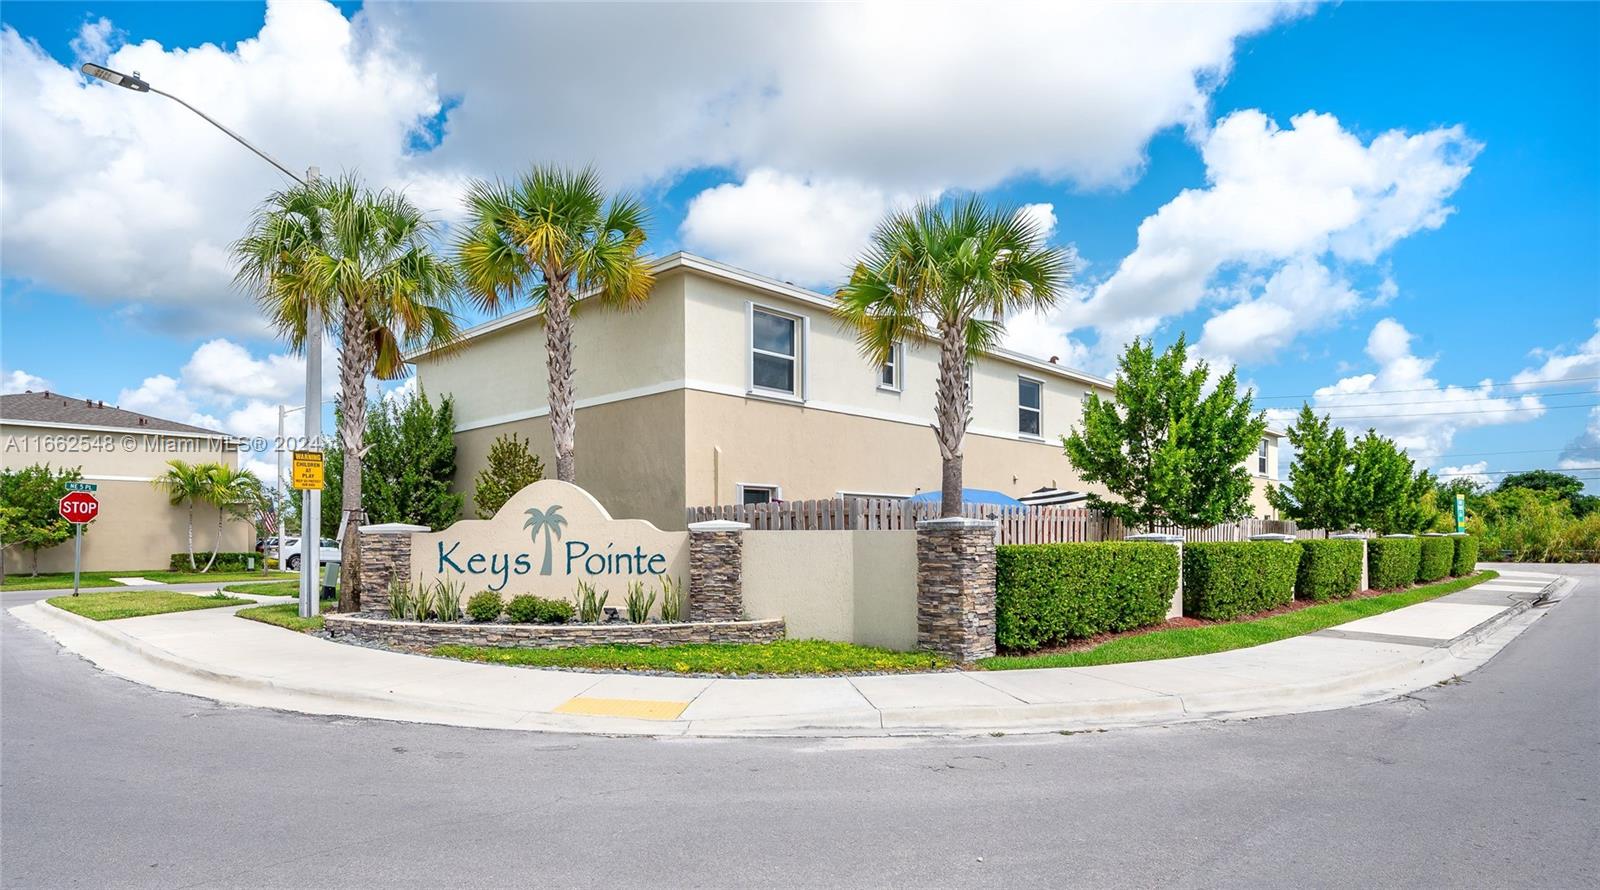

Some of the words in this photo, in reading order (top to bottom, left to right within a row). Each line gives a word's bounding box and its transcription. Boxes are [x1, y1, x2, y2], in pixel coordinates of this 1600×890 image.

[62, 501, 97, 514] STOP
[437, 541, 532, 592] Keys
[565, 541, 667, 575] Pointe
